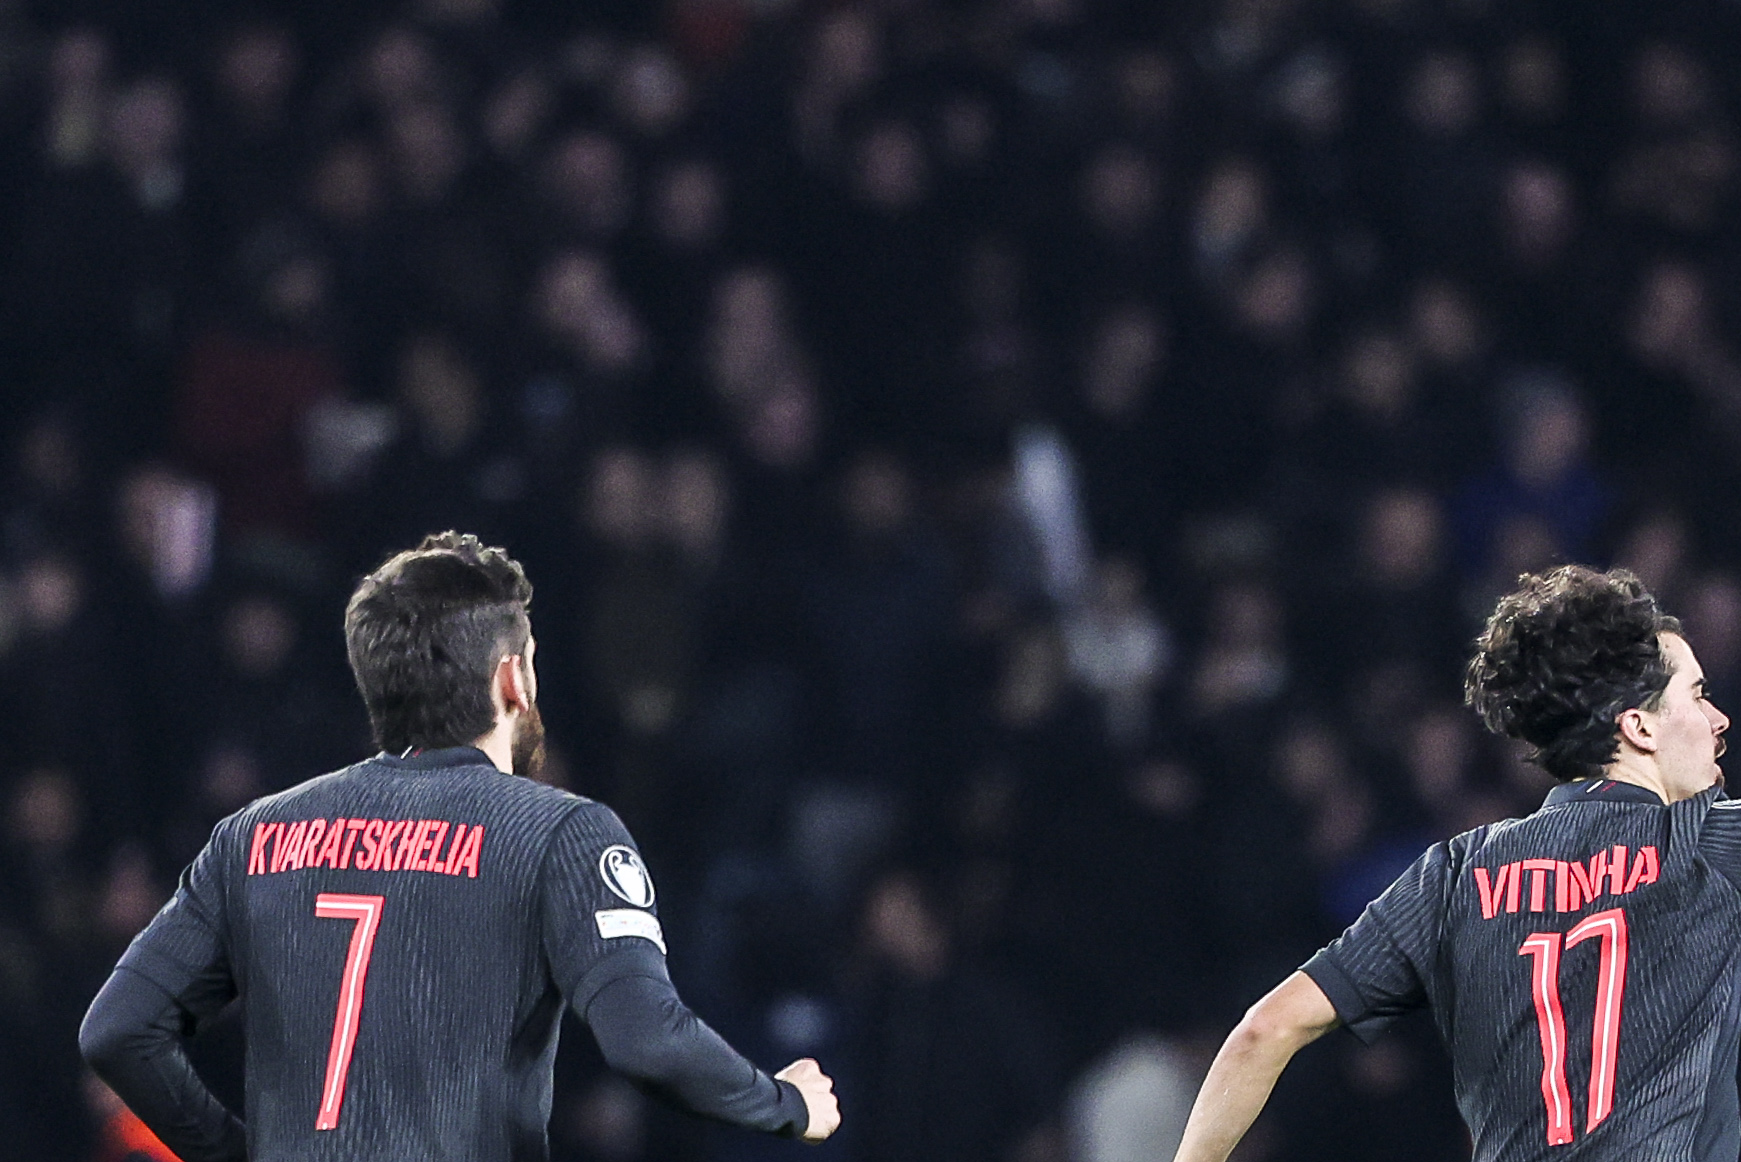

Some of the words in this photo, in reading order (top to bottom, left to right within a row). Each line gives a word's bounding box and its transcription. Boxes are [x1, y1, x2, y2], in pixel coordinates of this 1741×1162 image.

[248, 818, 485, 878] KVARATSKHELIA
[1474, 845, 1661, 920] VITINHA
[315, 893, 385, 1131] 7
[1518, 907, 1628, 1146] 17
